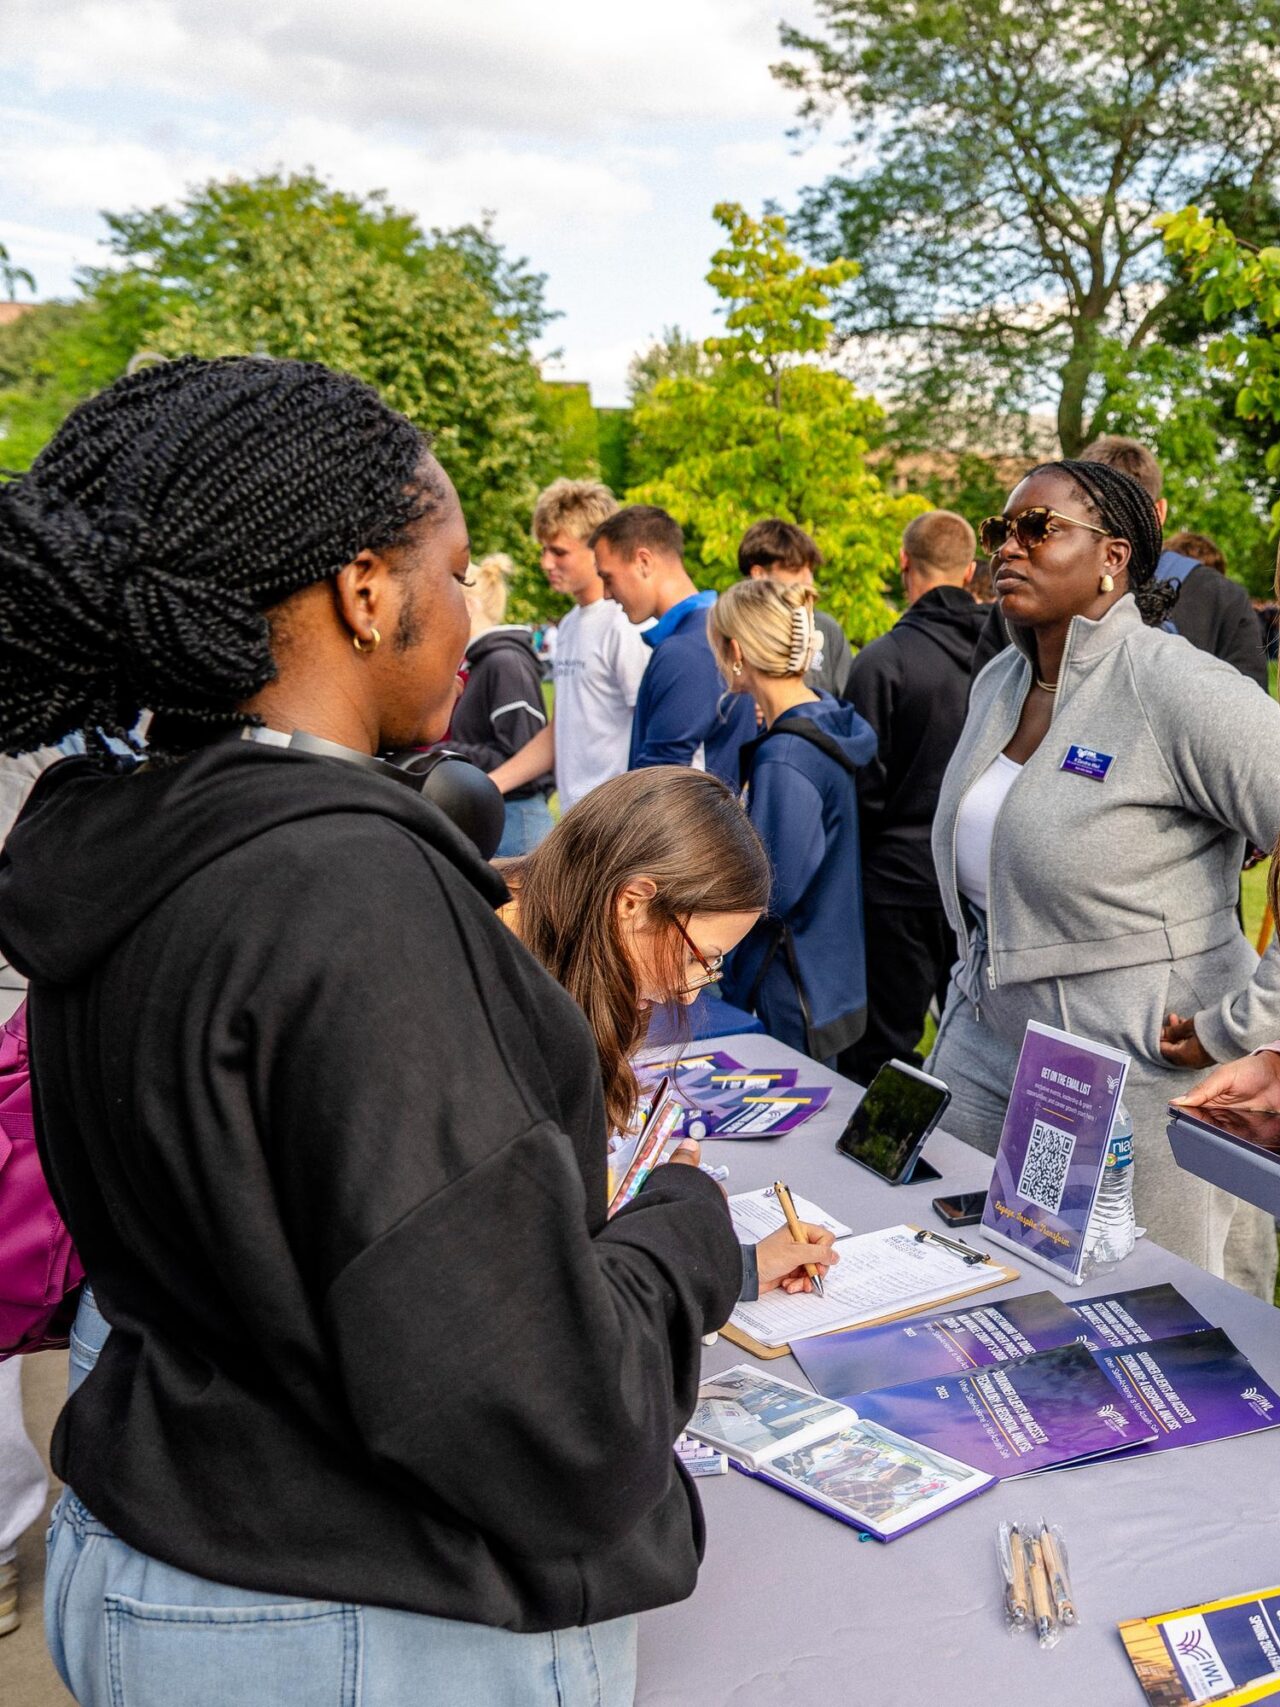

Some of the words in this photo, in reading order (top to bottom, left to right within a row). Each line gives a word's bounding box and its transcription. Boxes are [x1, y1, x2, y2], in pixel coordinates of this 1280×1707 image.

[1041, 1066, 1052, 1080] GET
[1050, 1070, 1058, 1082] ON
[1057, 1073, 1068, 1086] THE
[1066, 1076, 1081, 1092] EMAIL
[1080, 1082, 1092, 1096] LIST
[1248, 1614, 1270, 1641] SPRING
[1260, 1639, 1278, 1658] 2024
[1199, 1660, 1223, 1687] IWL
